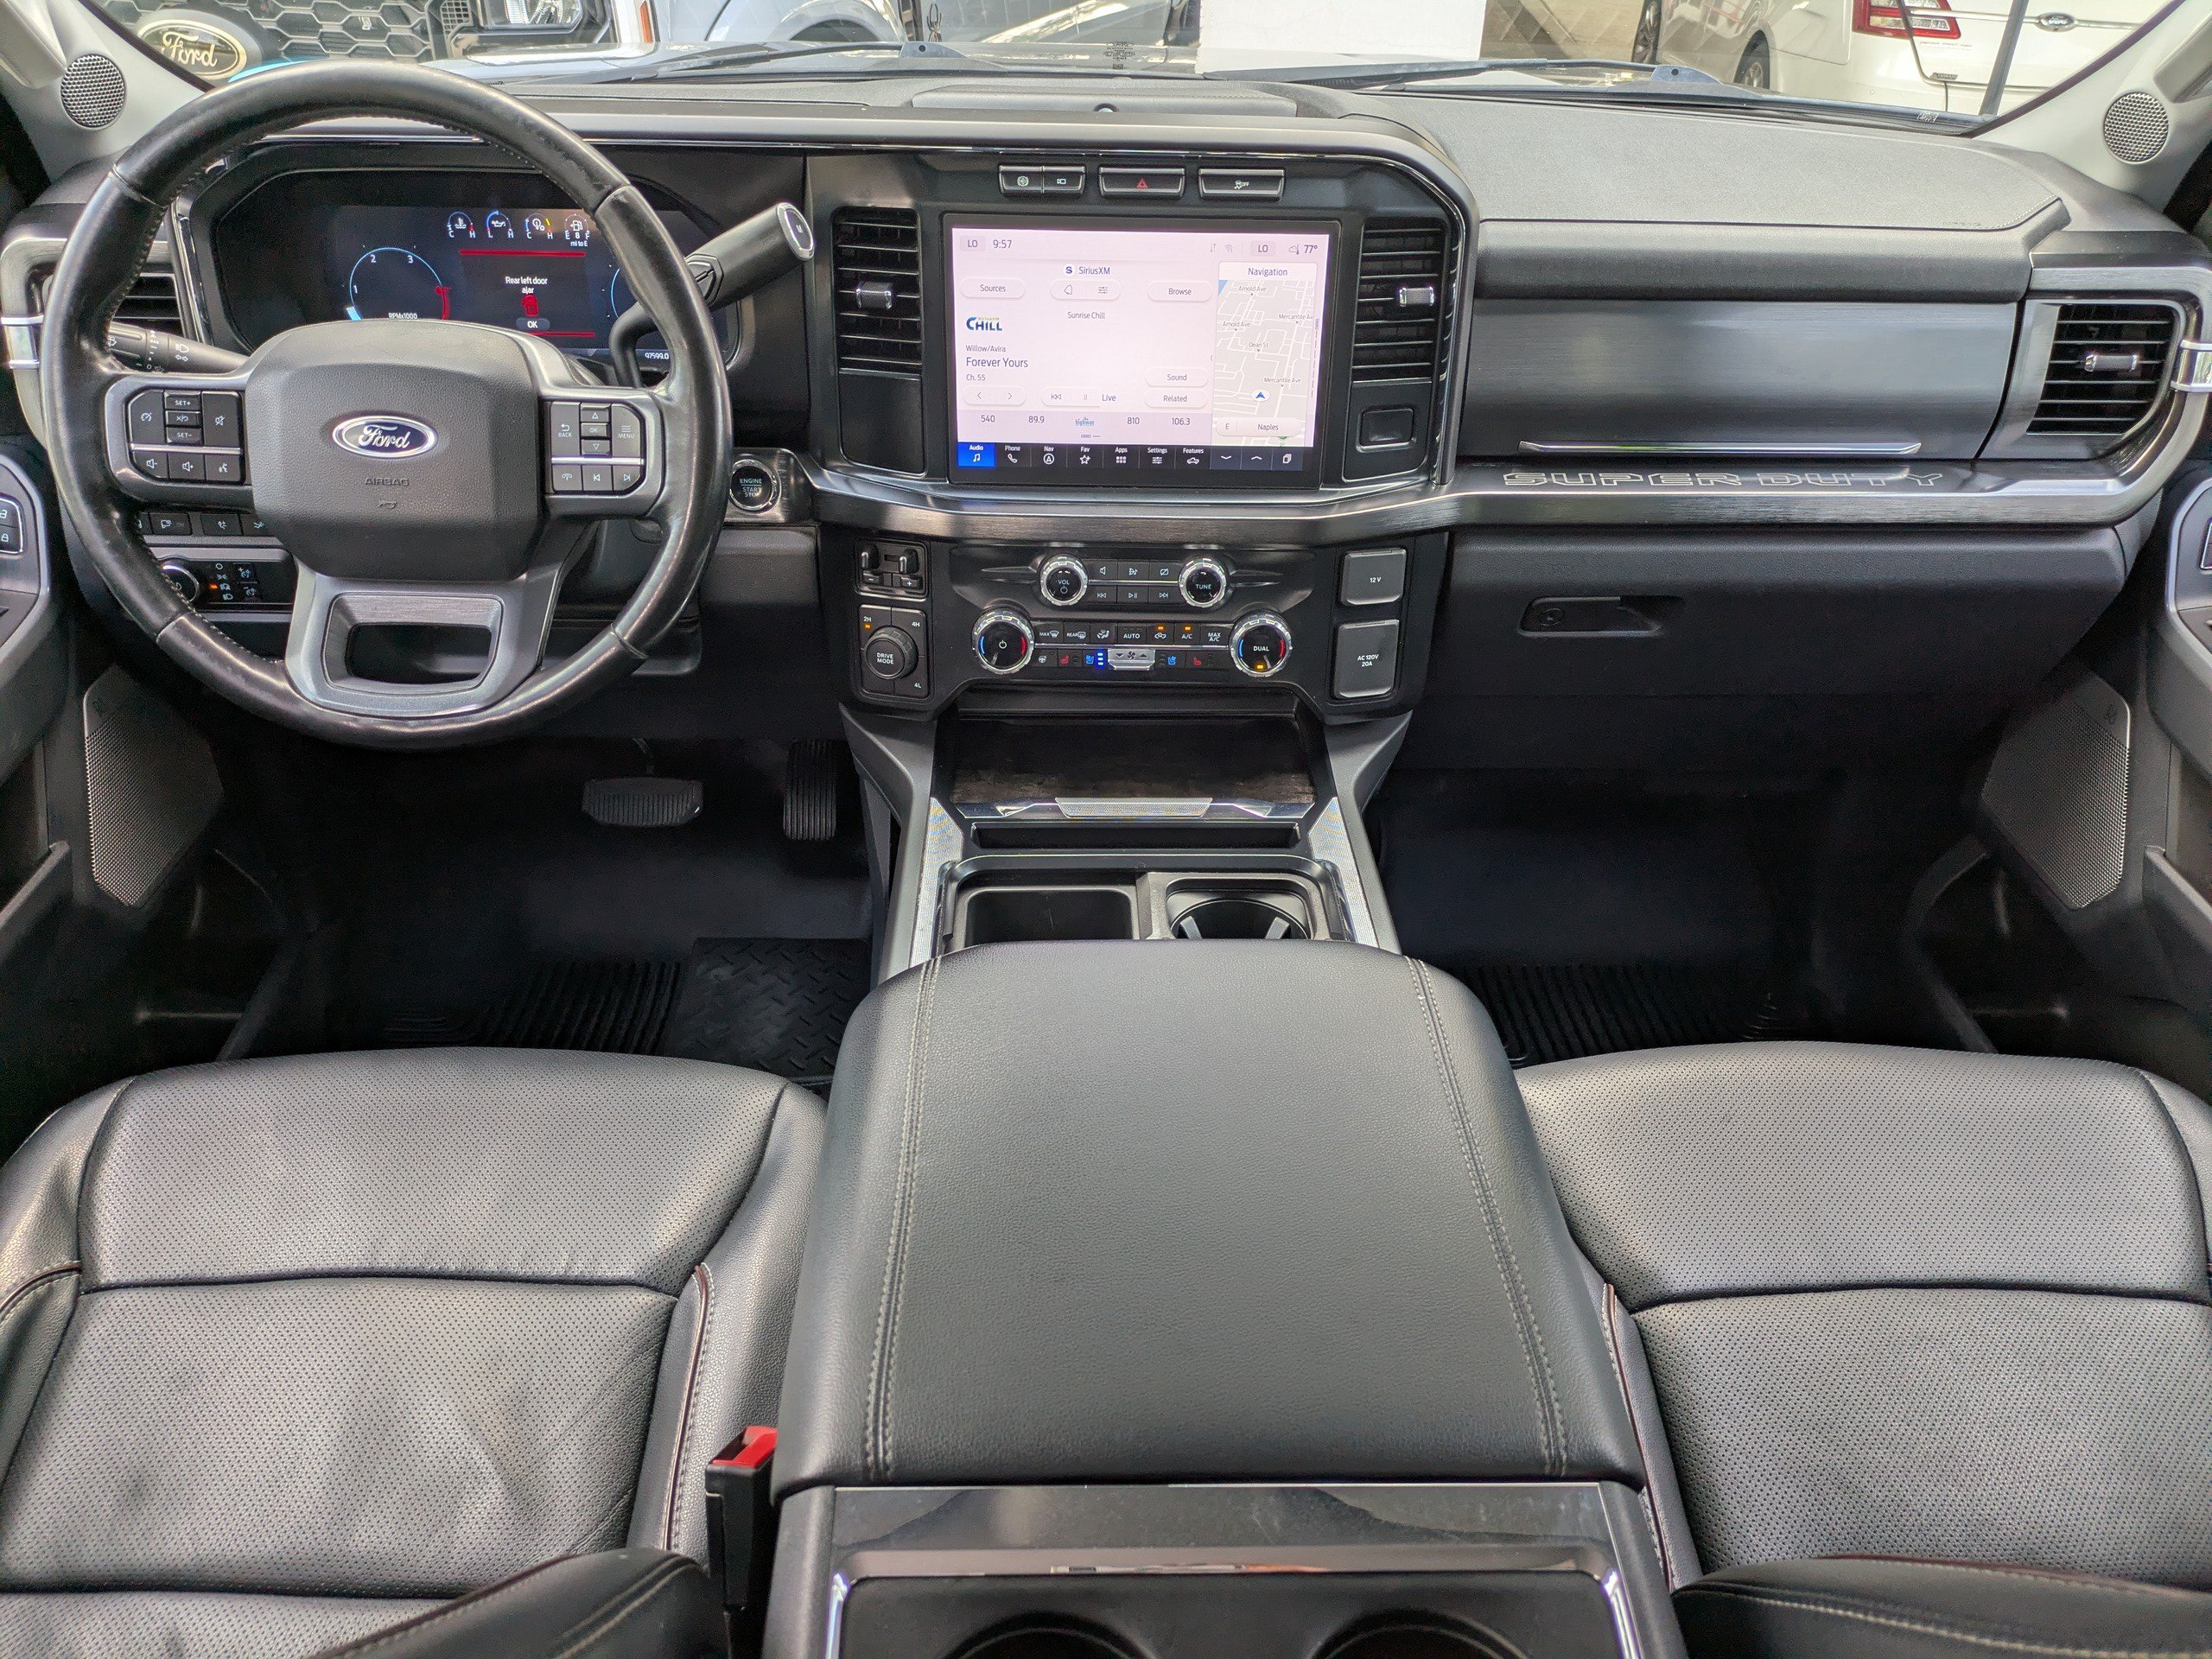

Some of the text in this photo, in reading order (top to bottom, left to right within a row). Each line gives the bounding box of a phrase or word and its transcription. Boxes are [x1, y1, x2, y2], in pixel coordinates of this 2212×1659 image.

[162, 31, 218, 67] Ford
[993, 239, 1012, 249] 9:57
[371, 254, 376, 263] 2
[408, 255, 413, 264] 3
[1078, 266, 1110, 275] SiriusXM
[1248, 268, 1288, 277] Navigation
[966, 316, 1002, 331] CHILL
[966, 357, 1028, 368] Forever Yours
[358, 424, 410, 448] Ford
[365, 478, 410, 486] AIRBAG
[1503, 472, 1943, 487] SUPER DUTY
